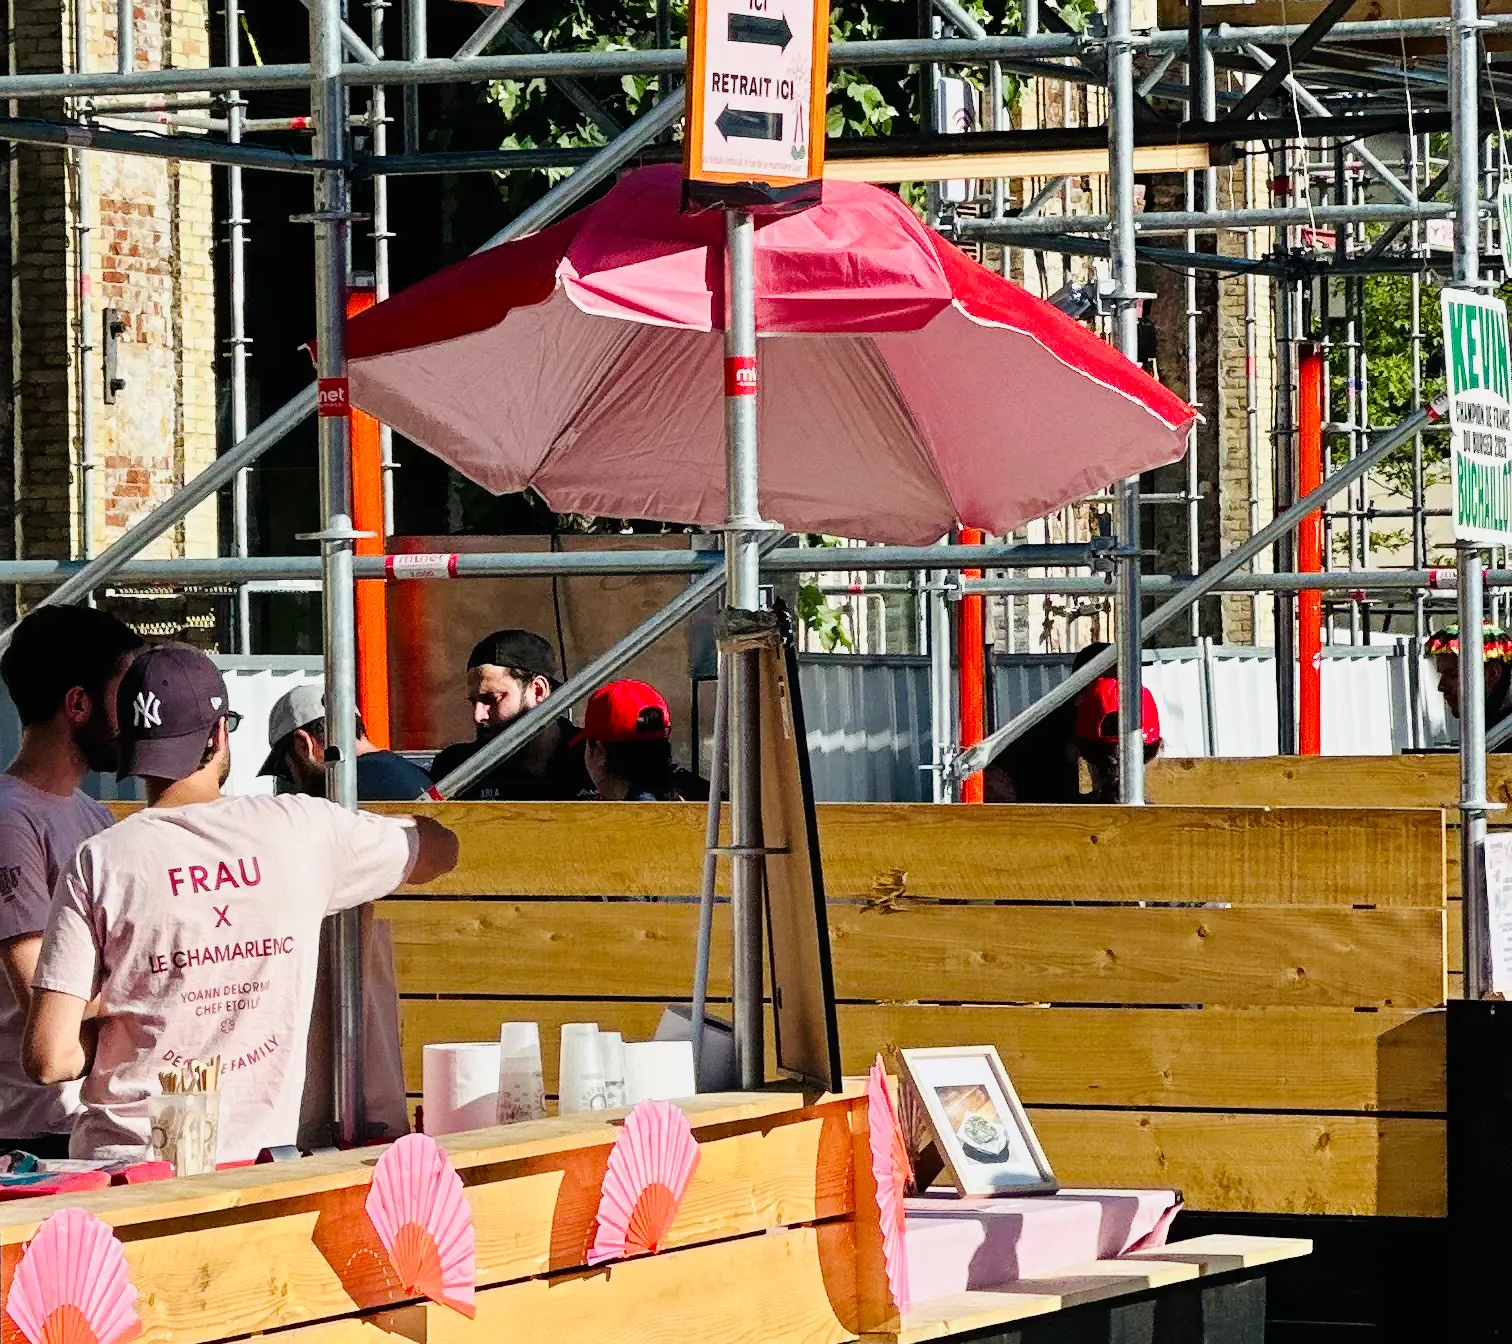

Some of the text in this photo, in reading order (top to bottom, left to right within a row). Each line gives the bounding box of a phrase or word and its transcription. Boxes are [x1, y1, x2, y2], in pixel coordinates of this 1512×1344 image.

[711, 72, 795, 101] RETRAIT ICI
[1448, 301, 1511, 405] KEVIN
[133, 691, 162, 728] NY
[168, 856, 263, 897] FRAU
[212, 904, 233, 929] X
[148, 936, 295, 975] LE CHAMARLENC
[180, 987, 221, 1004] YOANN
[195, 1003, 223, 1017] CHEF
[230, 1035, 281, 1072] FAMILY
